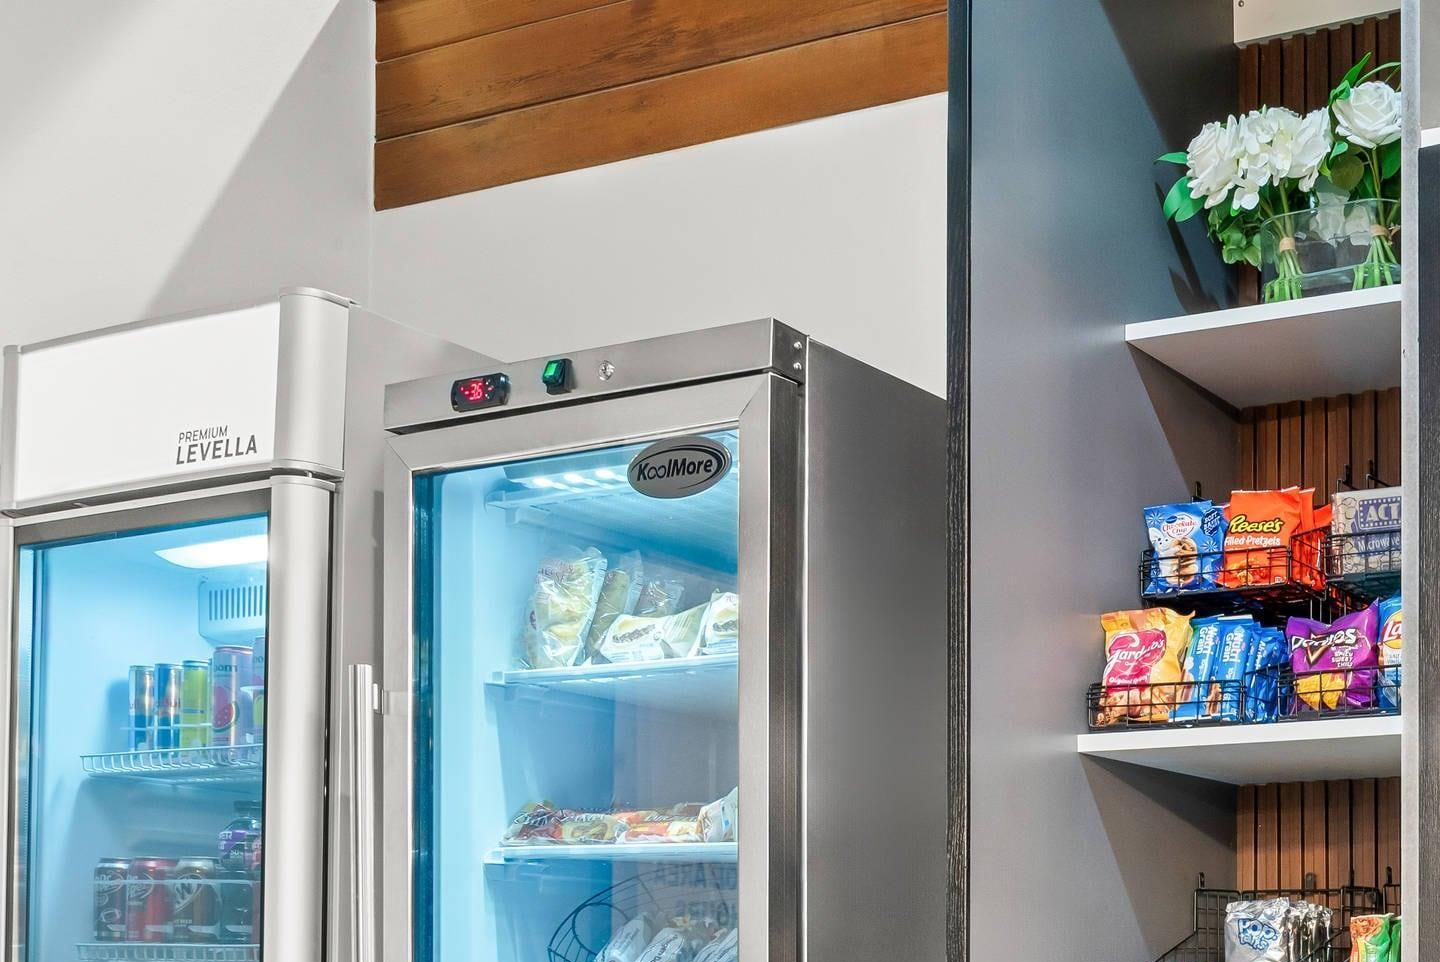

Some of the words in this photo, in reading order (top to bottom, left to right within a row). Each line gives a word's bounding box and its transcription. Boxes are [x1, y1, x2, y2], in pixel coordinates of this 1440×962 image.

[178, 425, 228, 443] PREMIUM
[176, 435, 257, 465] LEVELLA
[636, 452, 714, 482] KoolMore
[1366, 503, 1400, 522] ACT
[1229, 515, 1283, 534] Reese's
[1224, 537, 1244, 547] Filled
[1246, 535, 1281, 547] Pretzels
[1358, 532, 1401, 552] Mcrowve
